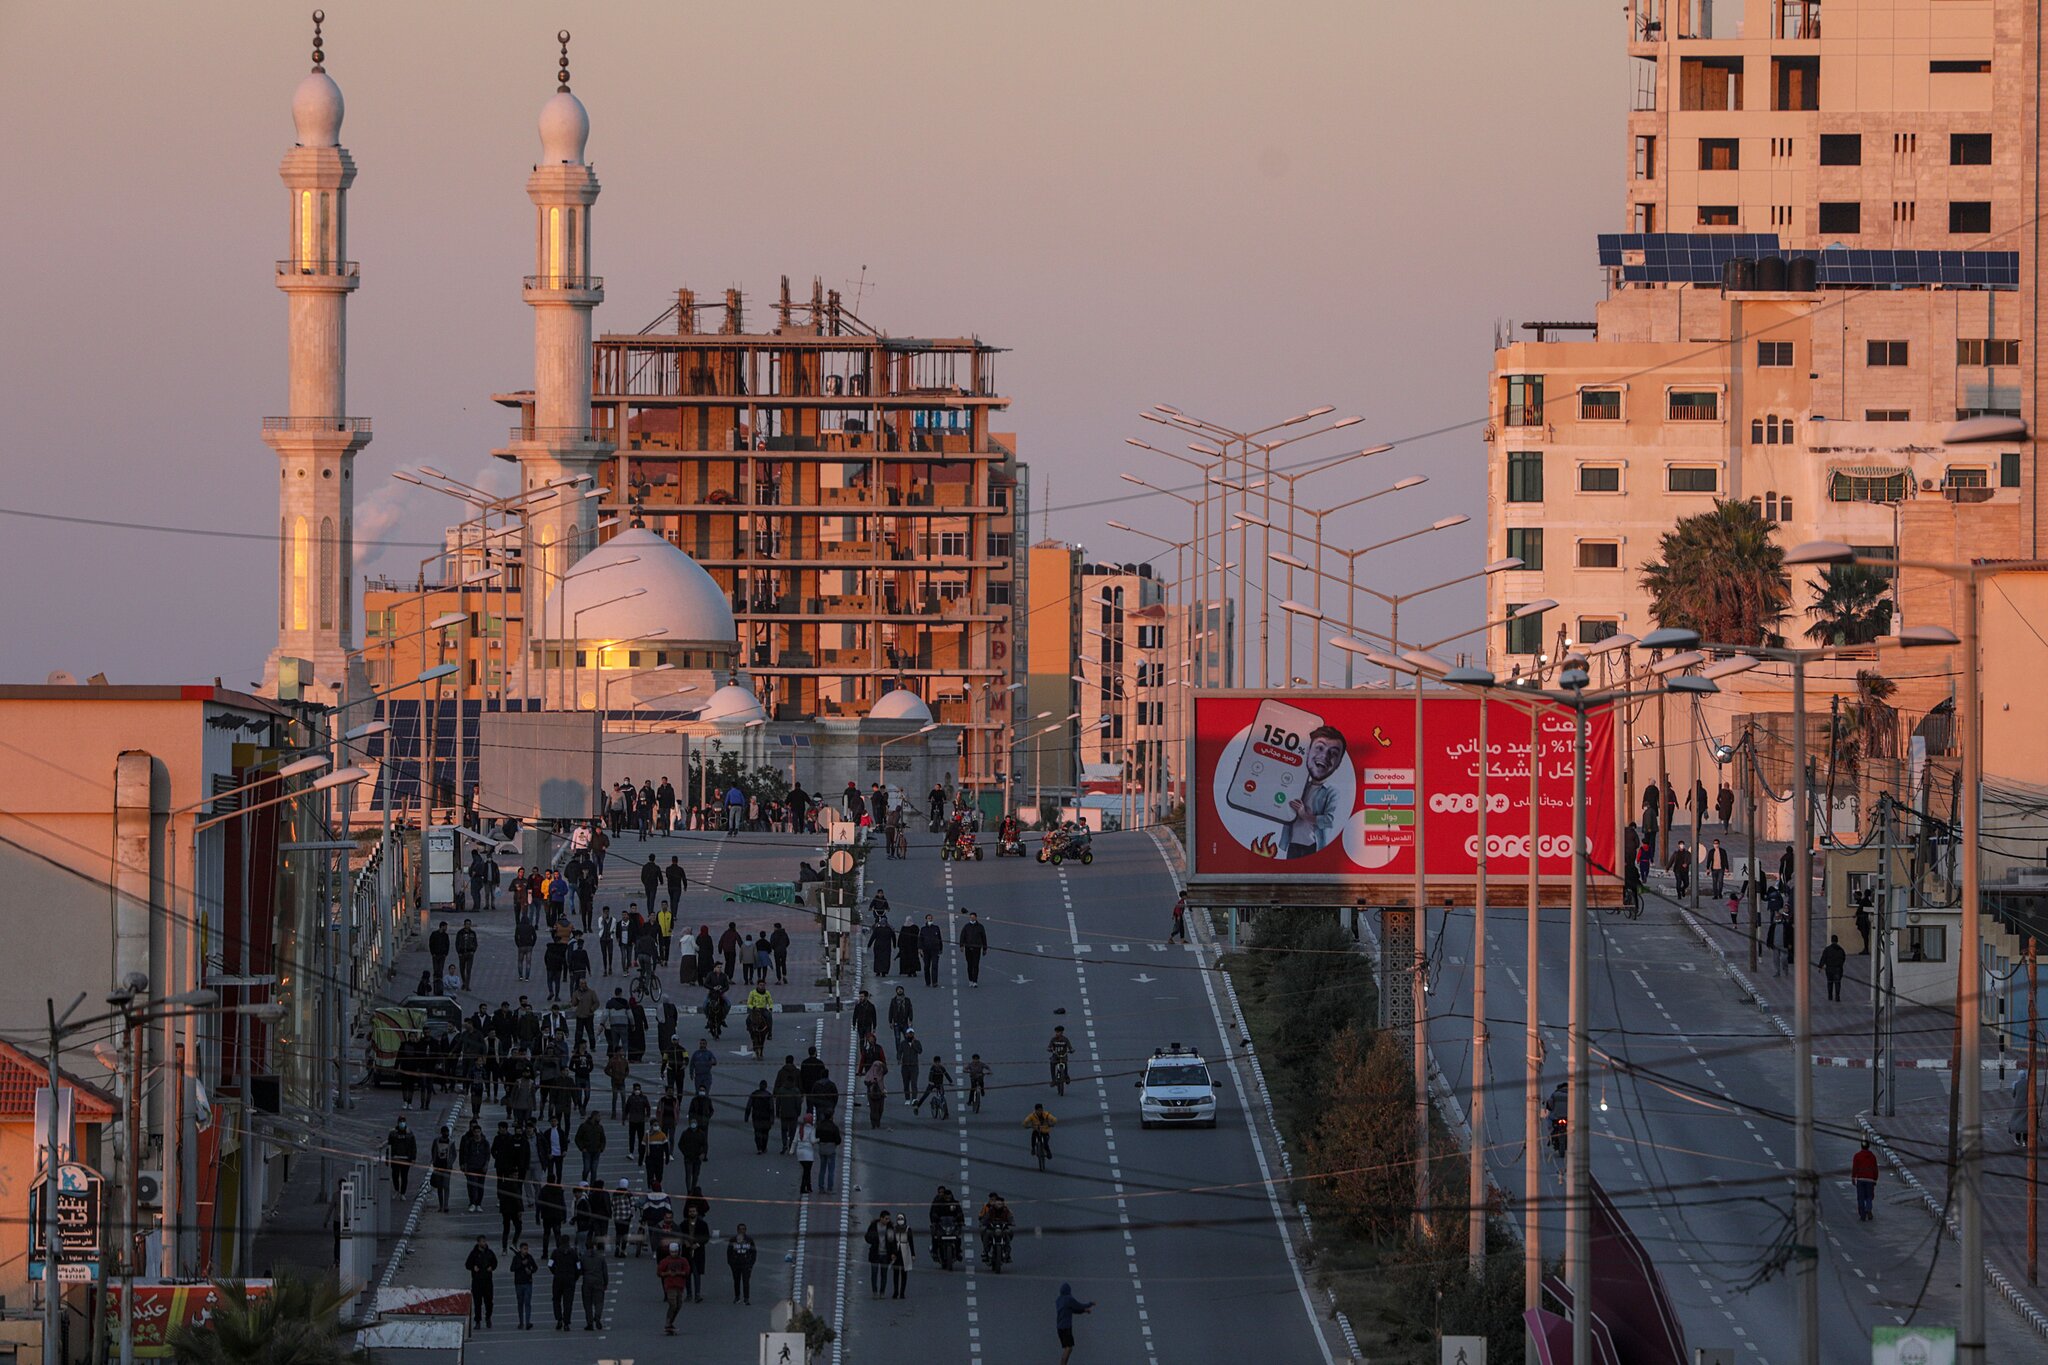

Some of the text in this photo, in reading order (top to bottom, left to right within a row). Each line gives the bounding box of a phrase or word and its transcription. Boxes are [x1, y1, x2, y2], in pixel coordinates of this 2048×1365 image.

[1542, 711, 1592, 737] وعت
[1263, 724, 1305, 755] 150%
[1467, 760, 1543, 781] اشبكات
[1434, 796, 1506, 810] 78#
[1513, 796, 1533, 808] لى
[1566, 796, 1592, 808] اتل
[1380, 813, 1398, 822] جوال
[1390, 834, 1412, 842] القدس
[1467, 835, 1590, 856] ooredo
